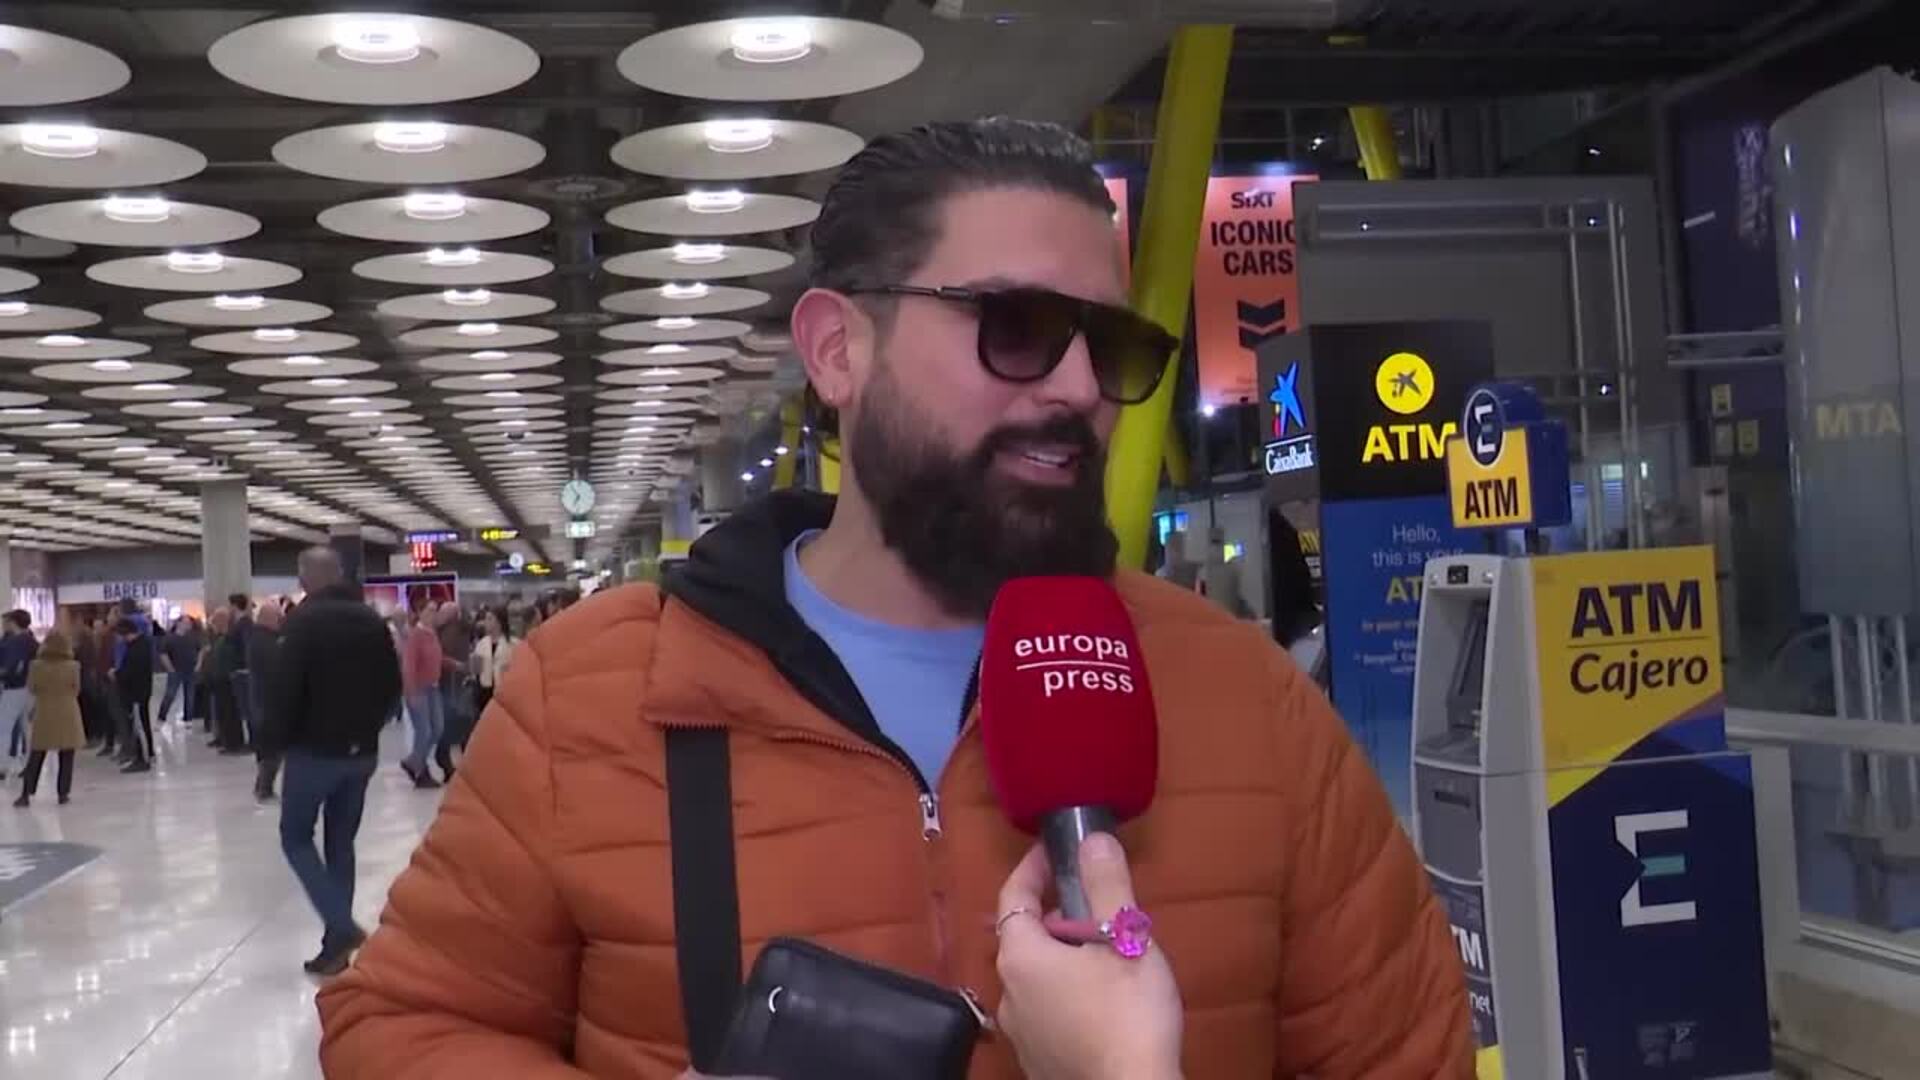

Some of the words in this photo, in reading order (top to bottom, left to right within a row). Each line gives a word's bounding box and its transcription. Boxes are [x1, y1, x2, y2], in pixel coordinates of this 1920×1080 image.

[1210, 220, 1296, 247] ICONIC
[1223, 251, 1294, 276] CARS
[1362, 422, 1456, 463] ATM
[1264, 444, 1315, 474] CaixaBank
[1464, 477, 1519, 520] ATM
[1392, 523, 1441, 543] Hello,
[1372, 551, 1404, 567] this
[1408, 551, 1422, 565] is
[1388, 577, 1423, 603] AT
[1570, 581, 1701, 639] ATM
[1014, 634, 1129, 660] europa
[1043, 669, 1134, 698] press
[1570, 651, 1709, 700] Cajero
[1468, 992, 1493, 1013] net
